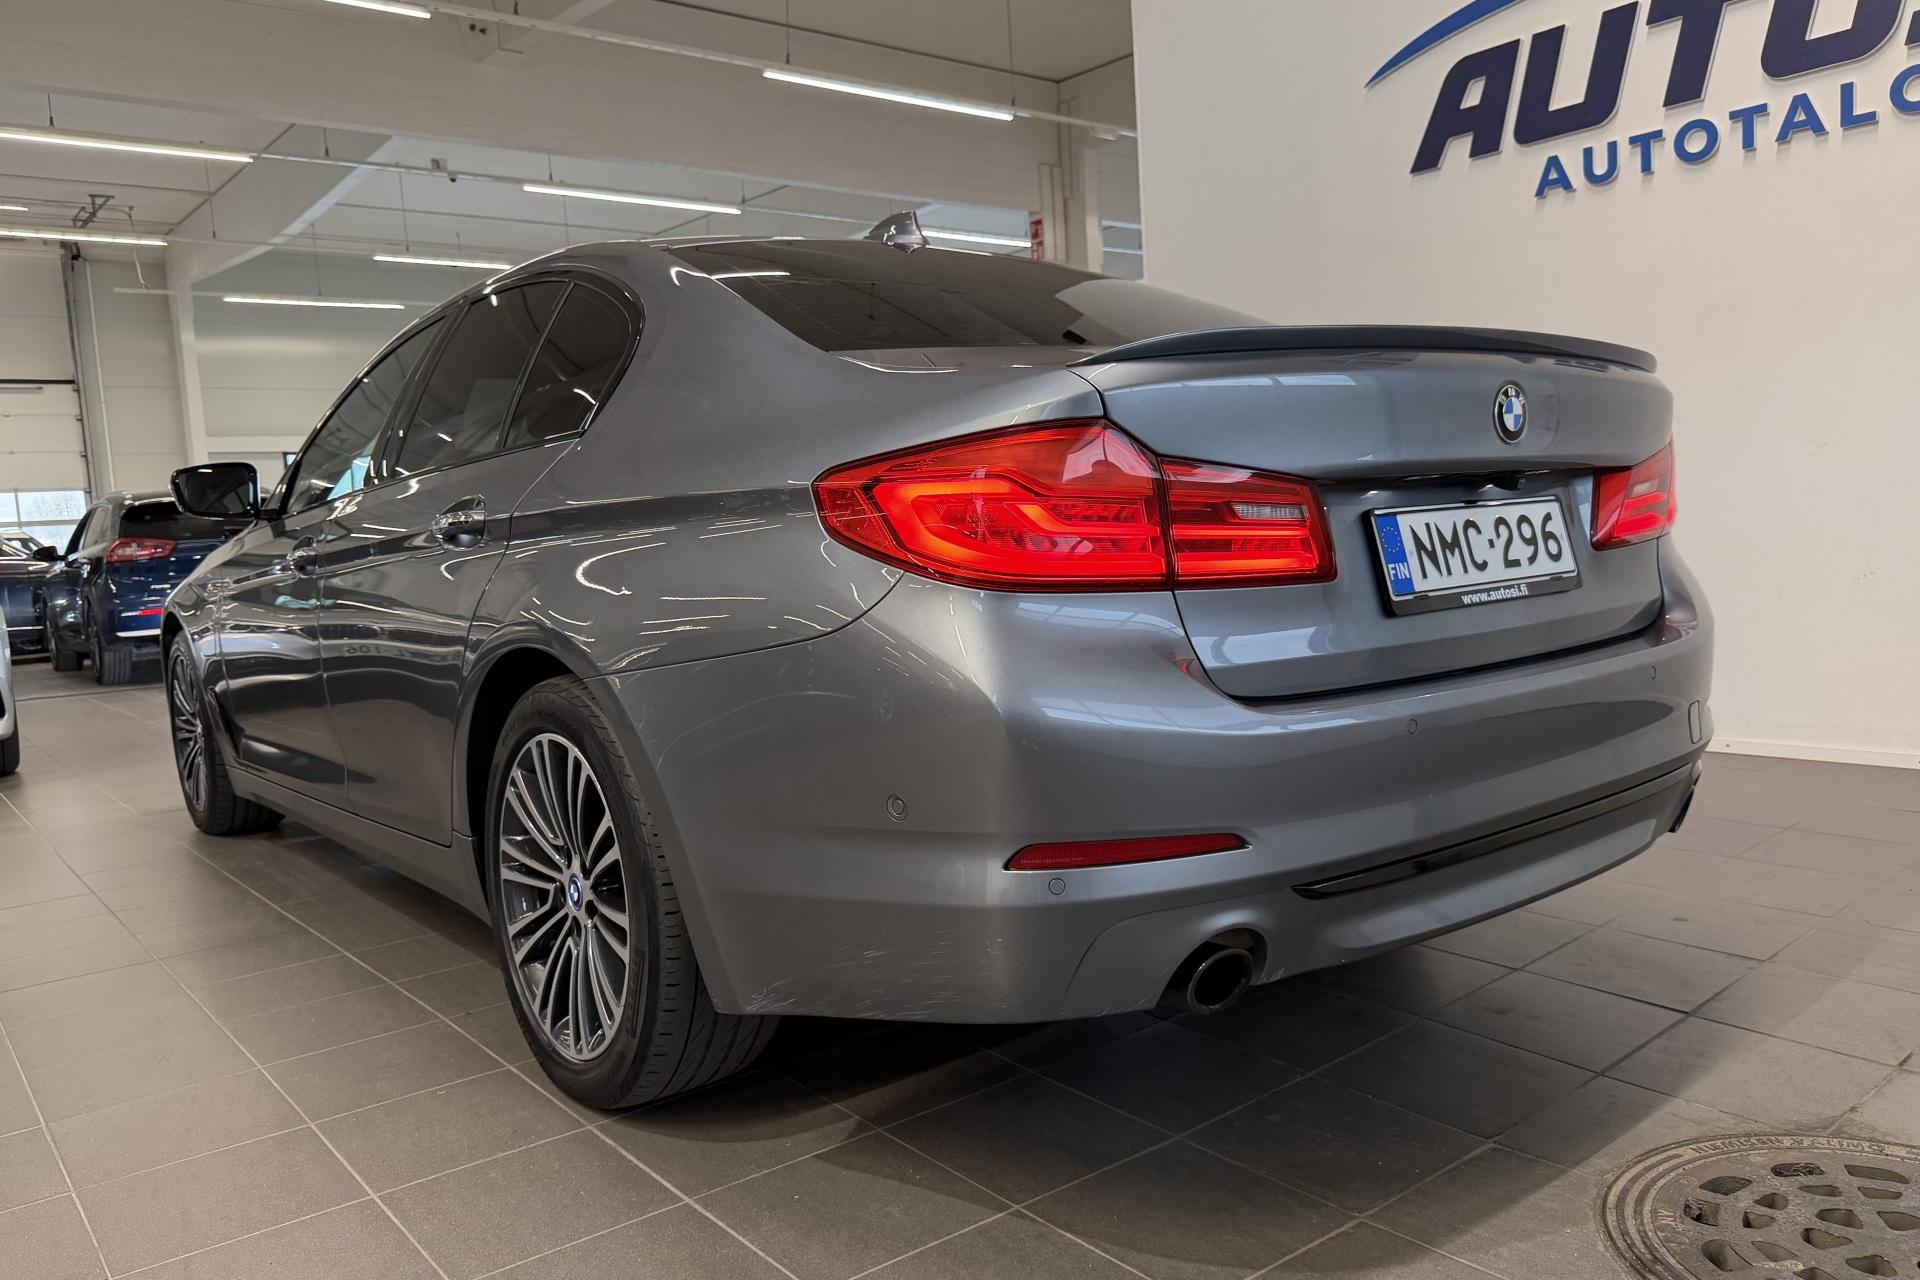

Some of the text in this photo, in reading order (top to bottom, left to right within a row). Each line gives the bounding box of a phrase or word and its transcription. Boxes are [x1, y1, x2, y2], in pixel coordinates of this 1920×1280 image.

[1410, 0, 1920, 174] AUTO
[1409, 511, 1562, 579] NMC-296
[1388, 563, 1410, 580] FIN
[1461, 584, 1529, 605] www.autosi.fi
